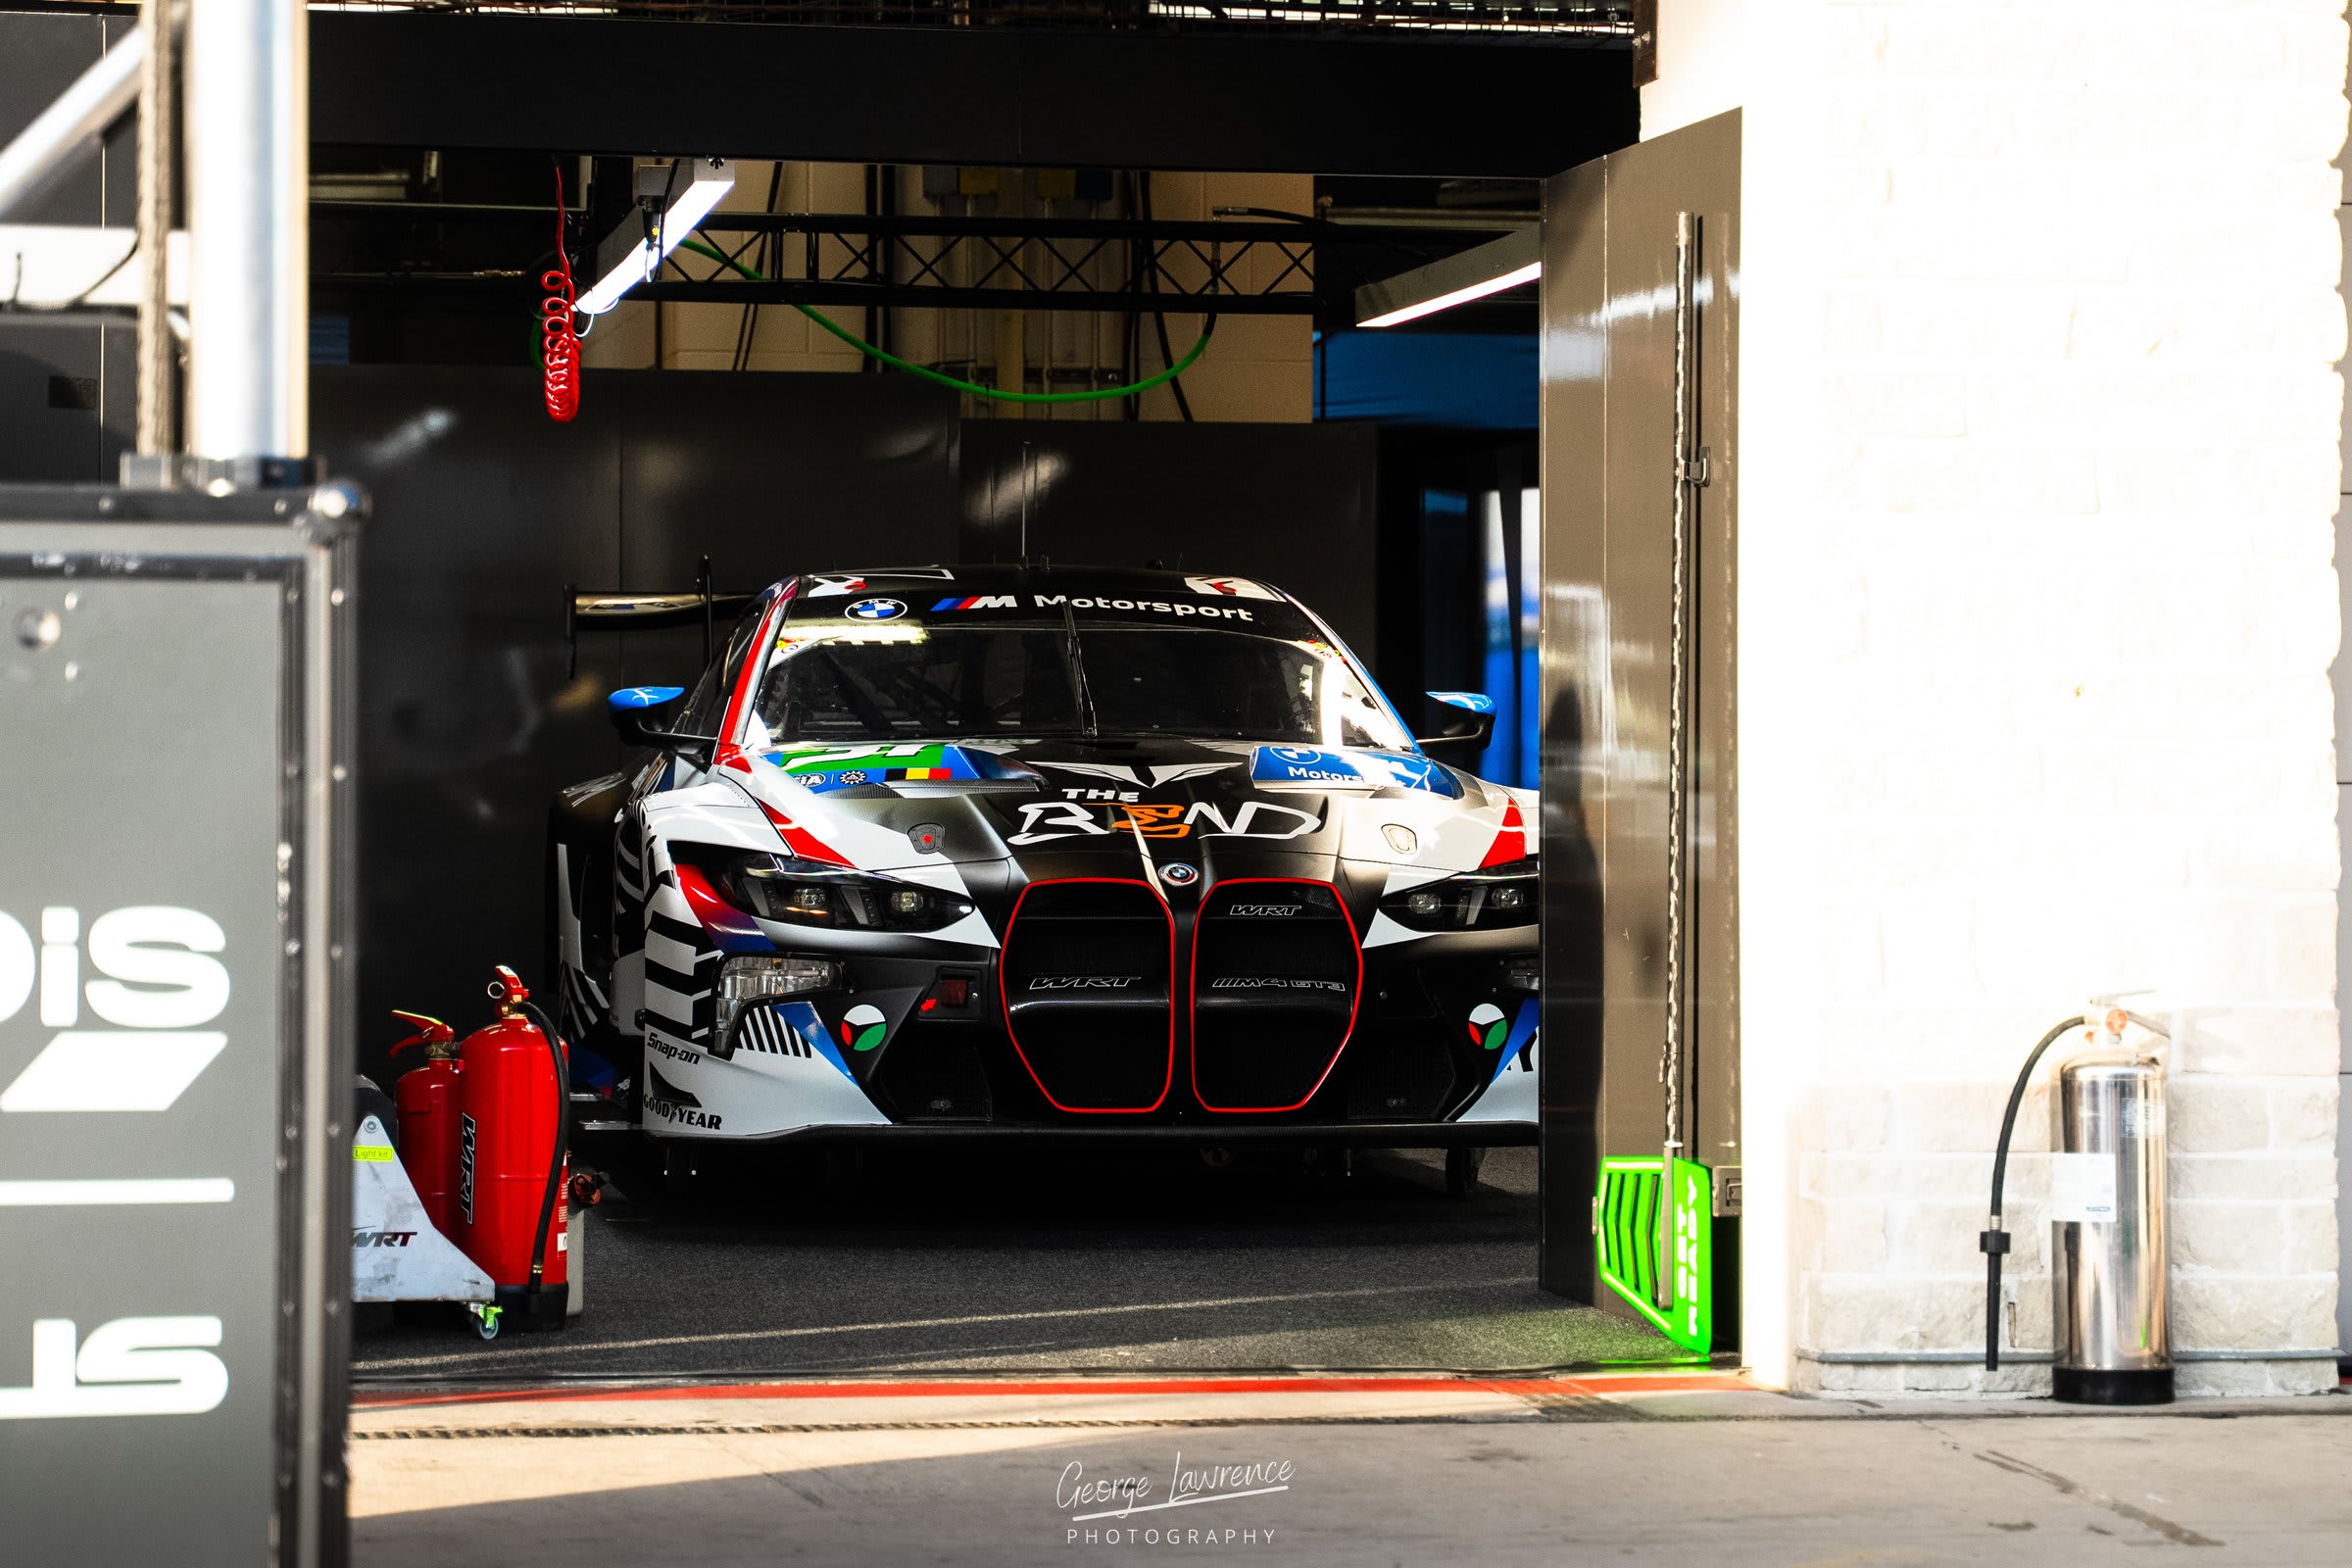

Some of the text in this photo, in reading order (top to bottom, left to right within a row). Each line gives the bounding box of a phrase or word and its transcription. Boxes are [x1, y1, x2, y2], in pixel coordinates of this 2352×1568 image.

[1033, 594, 1253, 621] Motorsport
[1287, 765, 1366, 783] Motors
[1061, 788, 1140, 803] THE
[1229, 905, 1302, 917] WRT
[1029, 976, 1142, 990] WRT
[1290, 980, 1347, 992] GT3
[647, 1032, 701, 1065] Snap-on
[355, 1149, 388, 1159] Light kit
[461, 1113, 476, 1225] WRT
[351, 1231, 418, 1248] WRT
[1688, 1175, 1697, 1337] READY
